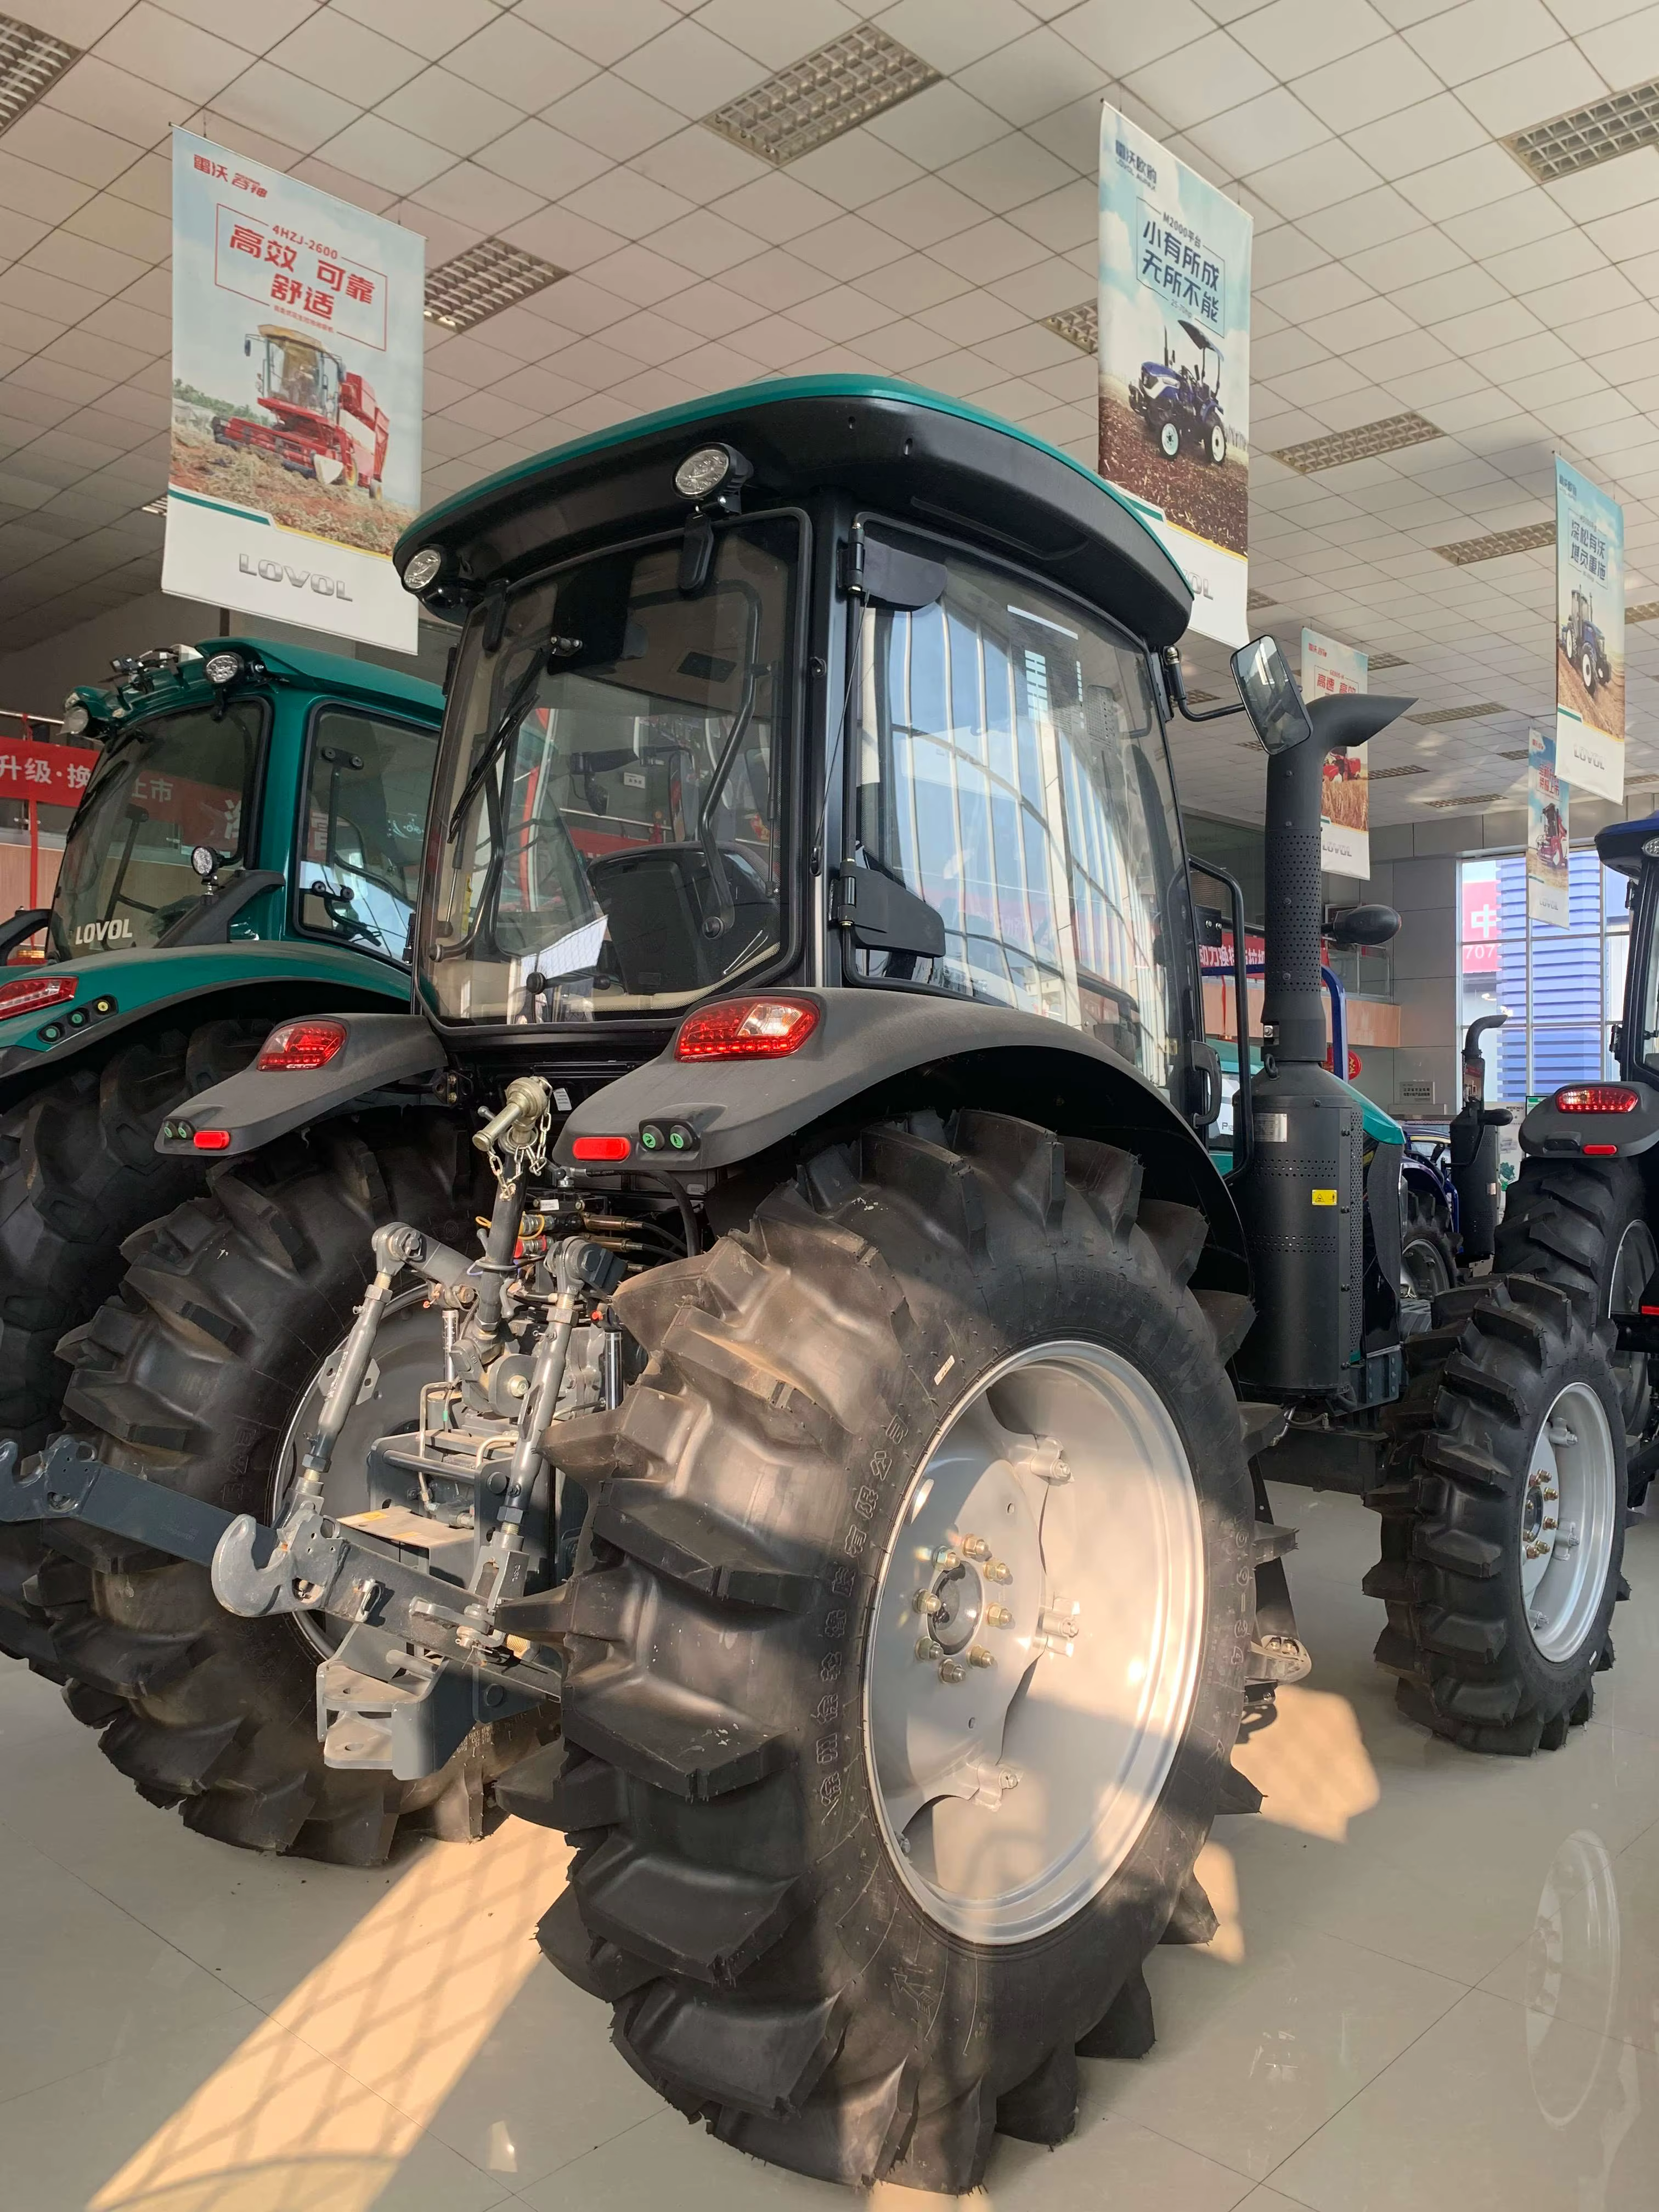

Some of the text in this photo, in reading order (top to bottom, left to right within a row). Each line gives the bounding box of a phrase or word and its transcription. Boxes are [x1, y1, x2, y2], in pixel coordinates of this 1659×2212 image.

[229, 224, 375, 304] 高效 可靠
[272, 225, 338, 260] 4HZJ-2600
[1143, 221, 1220, 292] 小有所成
[270, 273, 334, 320] 舒适
[1142, 249, 1218, 323] 无所不能
[239, 553, 353, 602] LOVOL
[1573, 742, 1605, 770] LOVOL
[75, 918, 133, 945] LOVOL
